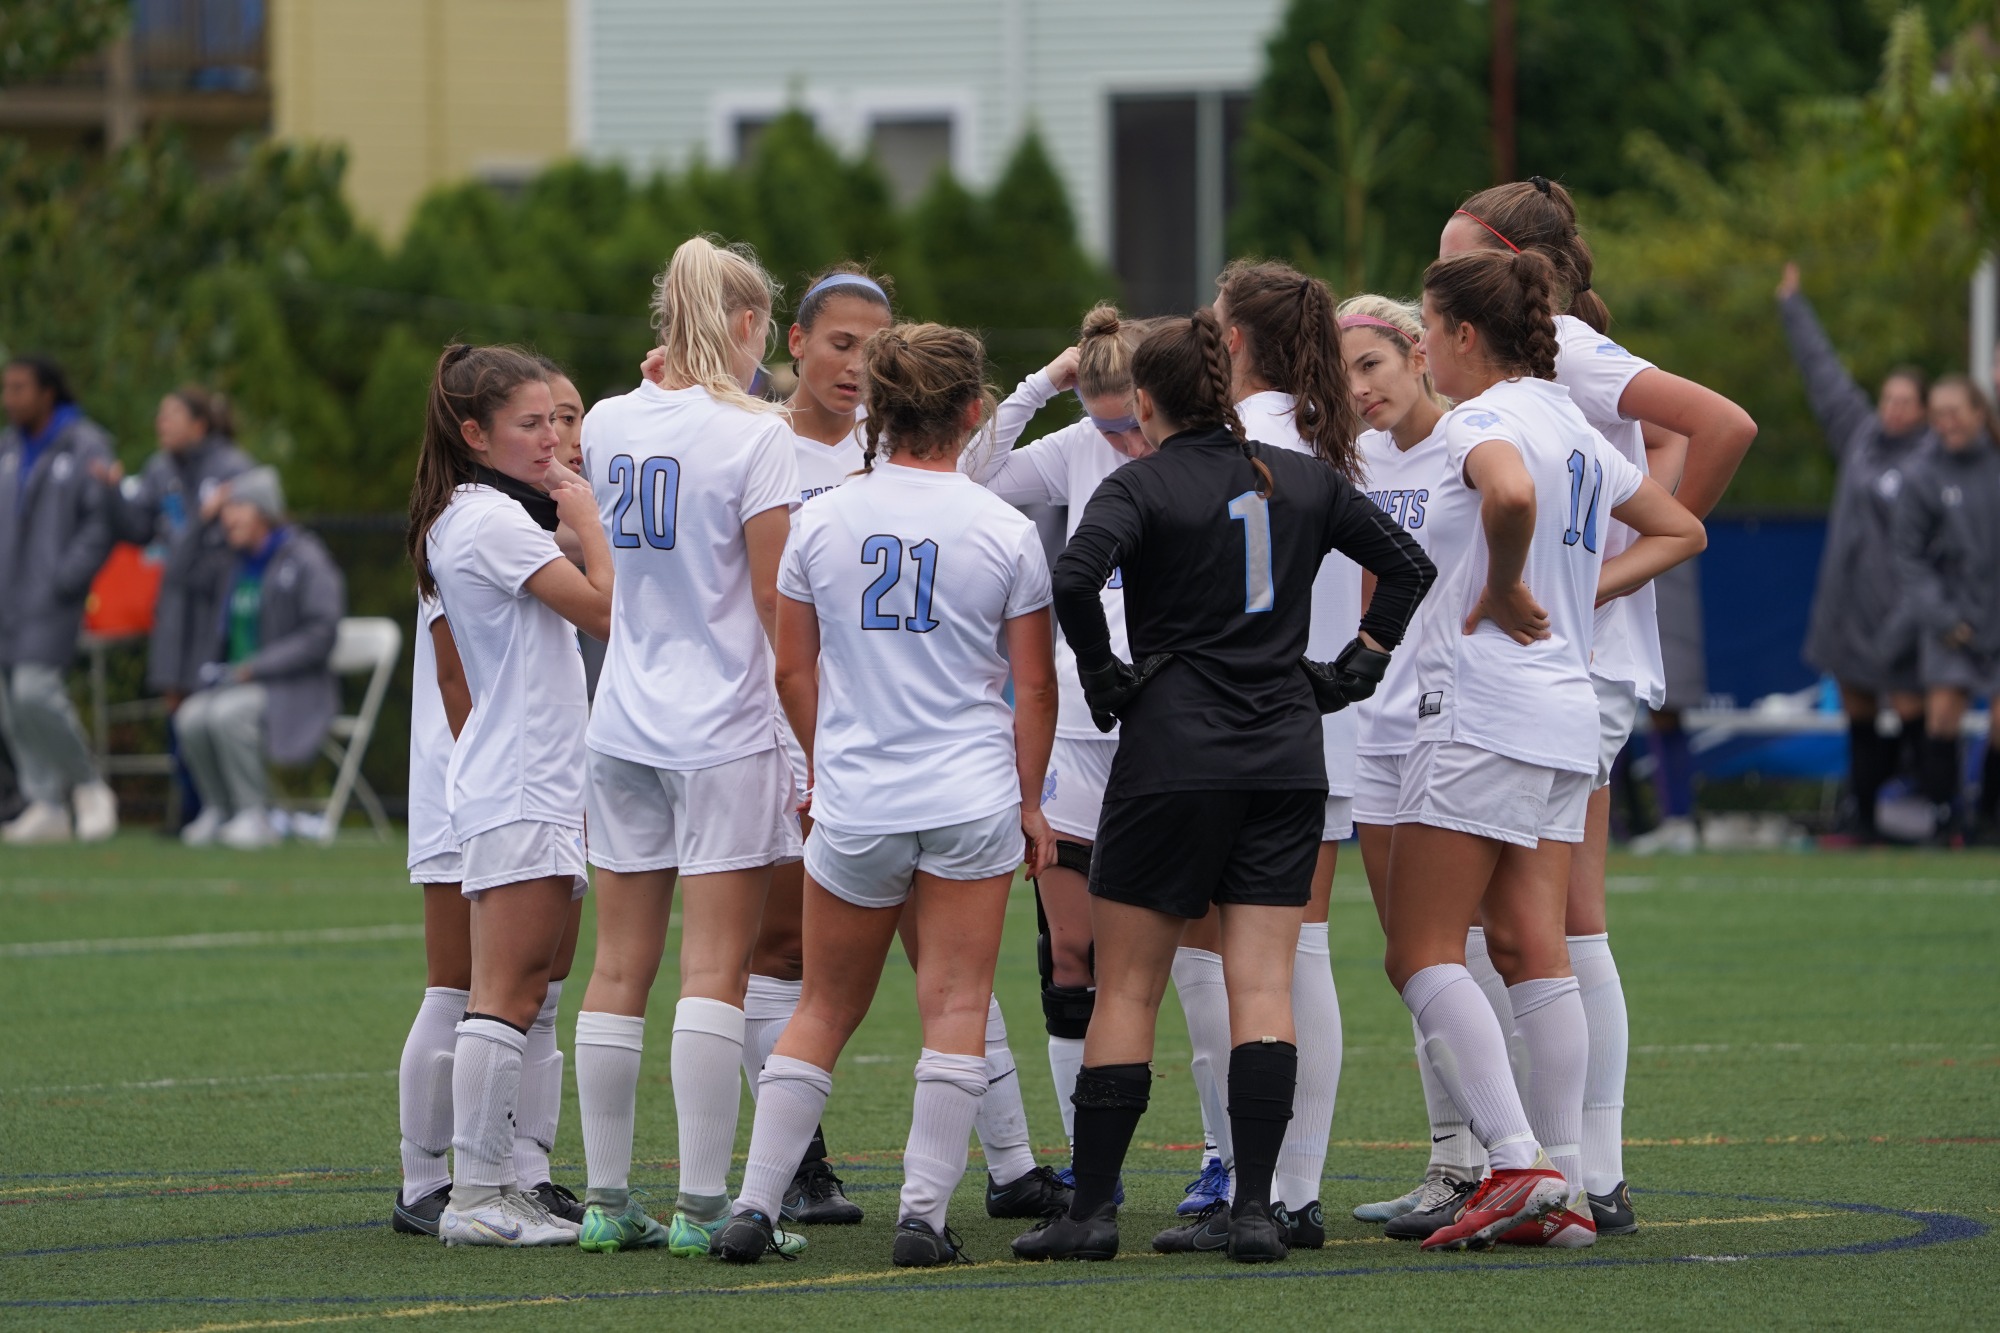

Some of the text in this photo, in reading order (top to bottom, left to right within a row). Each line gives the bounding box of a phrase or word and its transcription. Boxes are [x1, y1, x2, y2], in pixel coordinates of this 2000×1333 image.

[609, 453, 680, 551] 20
[1228, 490, 1274, 613] 1
[1366, 489, 1429, 529] FTS
[861, 533, 940, 633] 21
